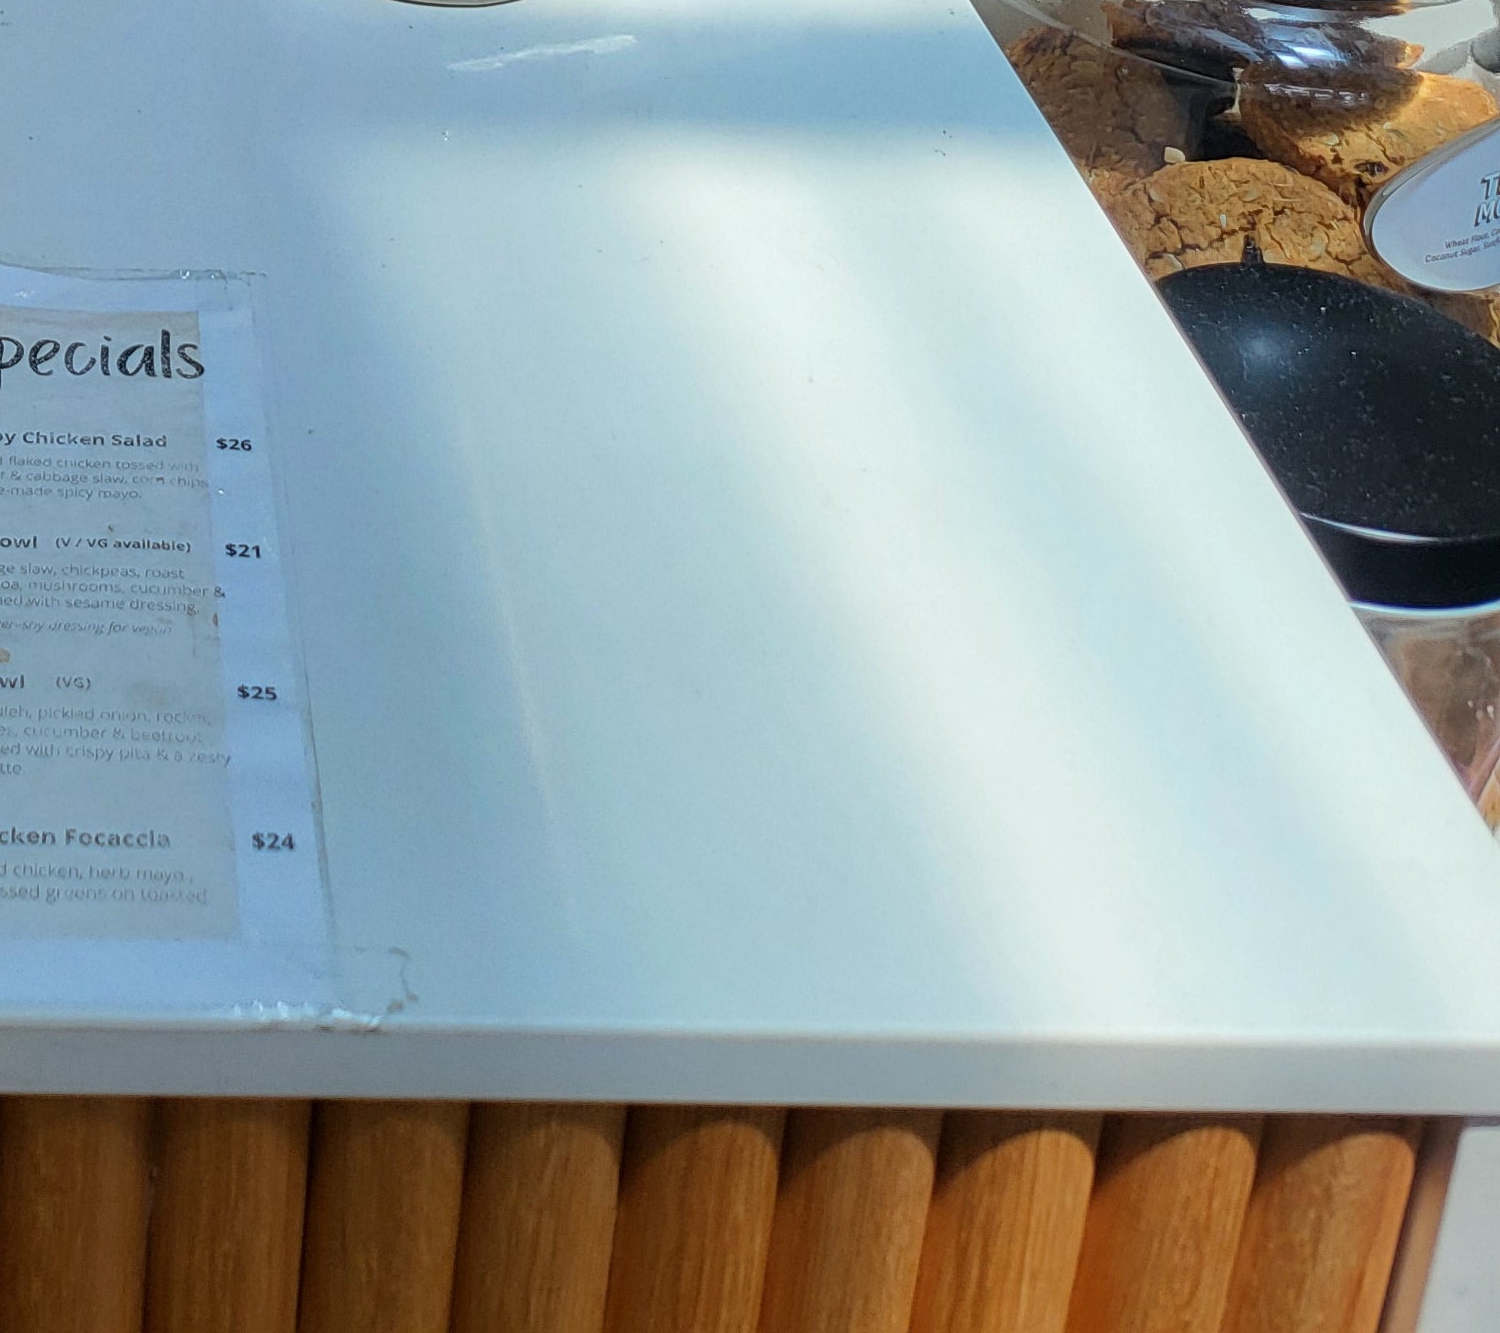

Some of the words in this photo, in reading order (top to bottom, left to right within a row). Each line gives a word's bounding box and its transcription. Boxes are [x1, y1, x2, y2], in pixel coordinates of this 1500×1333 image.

[1425, 250, 1459, 263] Coconut
[22, 431, 105, 446] Chicken
[111, 433, 168, 448] Salad
[215, 437, 252, 452] $26
[112, 538, 192, 553] available)
[225, 543, 262, 559] $21
[145, 566, 185, 580] roast
[237, 684, 278, 701] $25
[65, 827, 171, 849] Focaccia
[251, 832, 295, 851] $24
